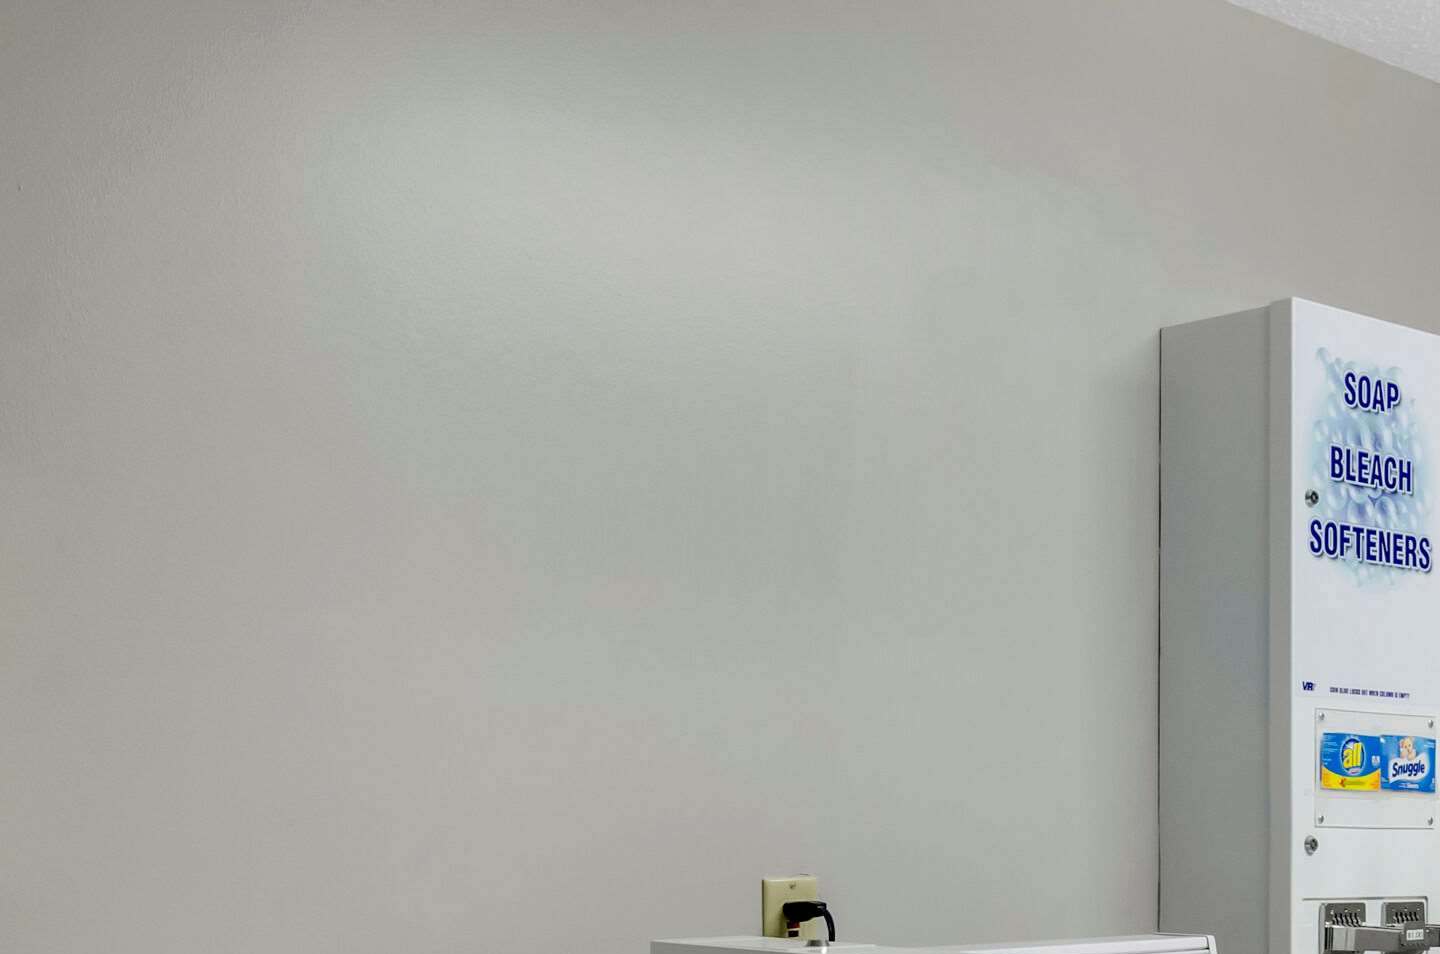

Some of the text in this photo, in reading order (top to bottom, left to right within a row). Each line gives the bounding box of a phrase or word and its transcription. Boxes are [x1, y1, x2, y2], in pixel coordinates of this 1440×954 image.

[1344, 372, 1399, 412] SOAP
[1330, 445, 1412, 493] BLEACH
[1310, 519, 1431, 570] SOFTENERS
[1343, 742, 1361, 769] all
[1392, 760, 1425, 778] Snuggle
